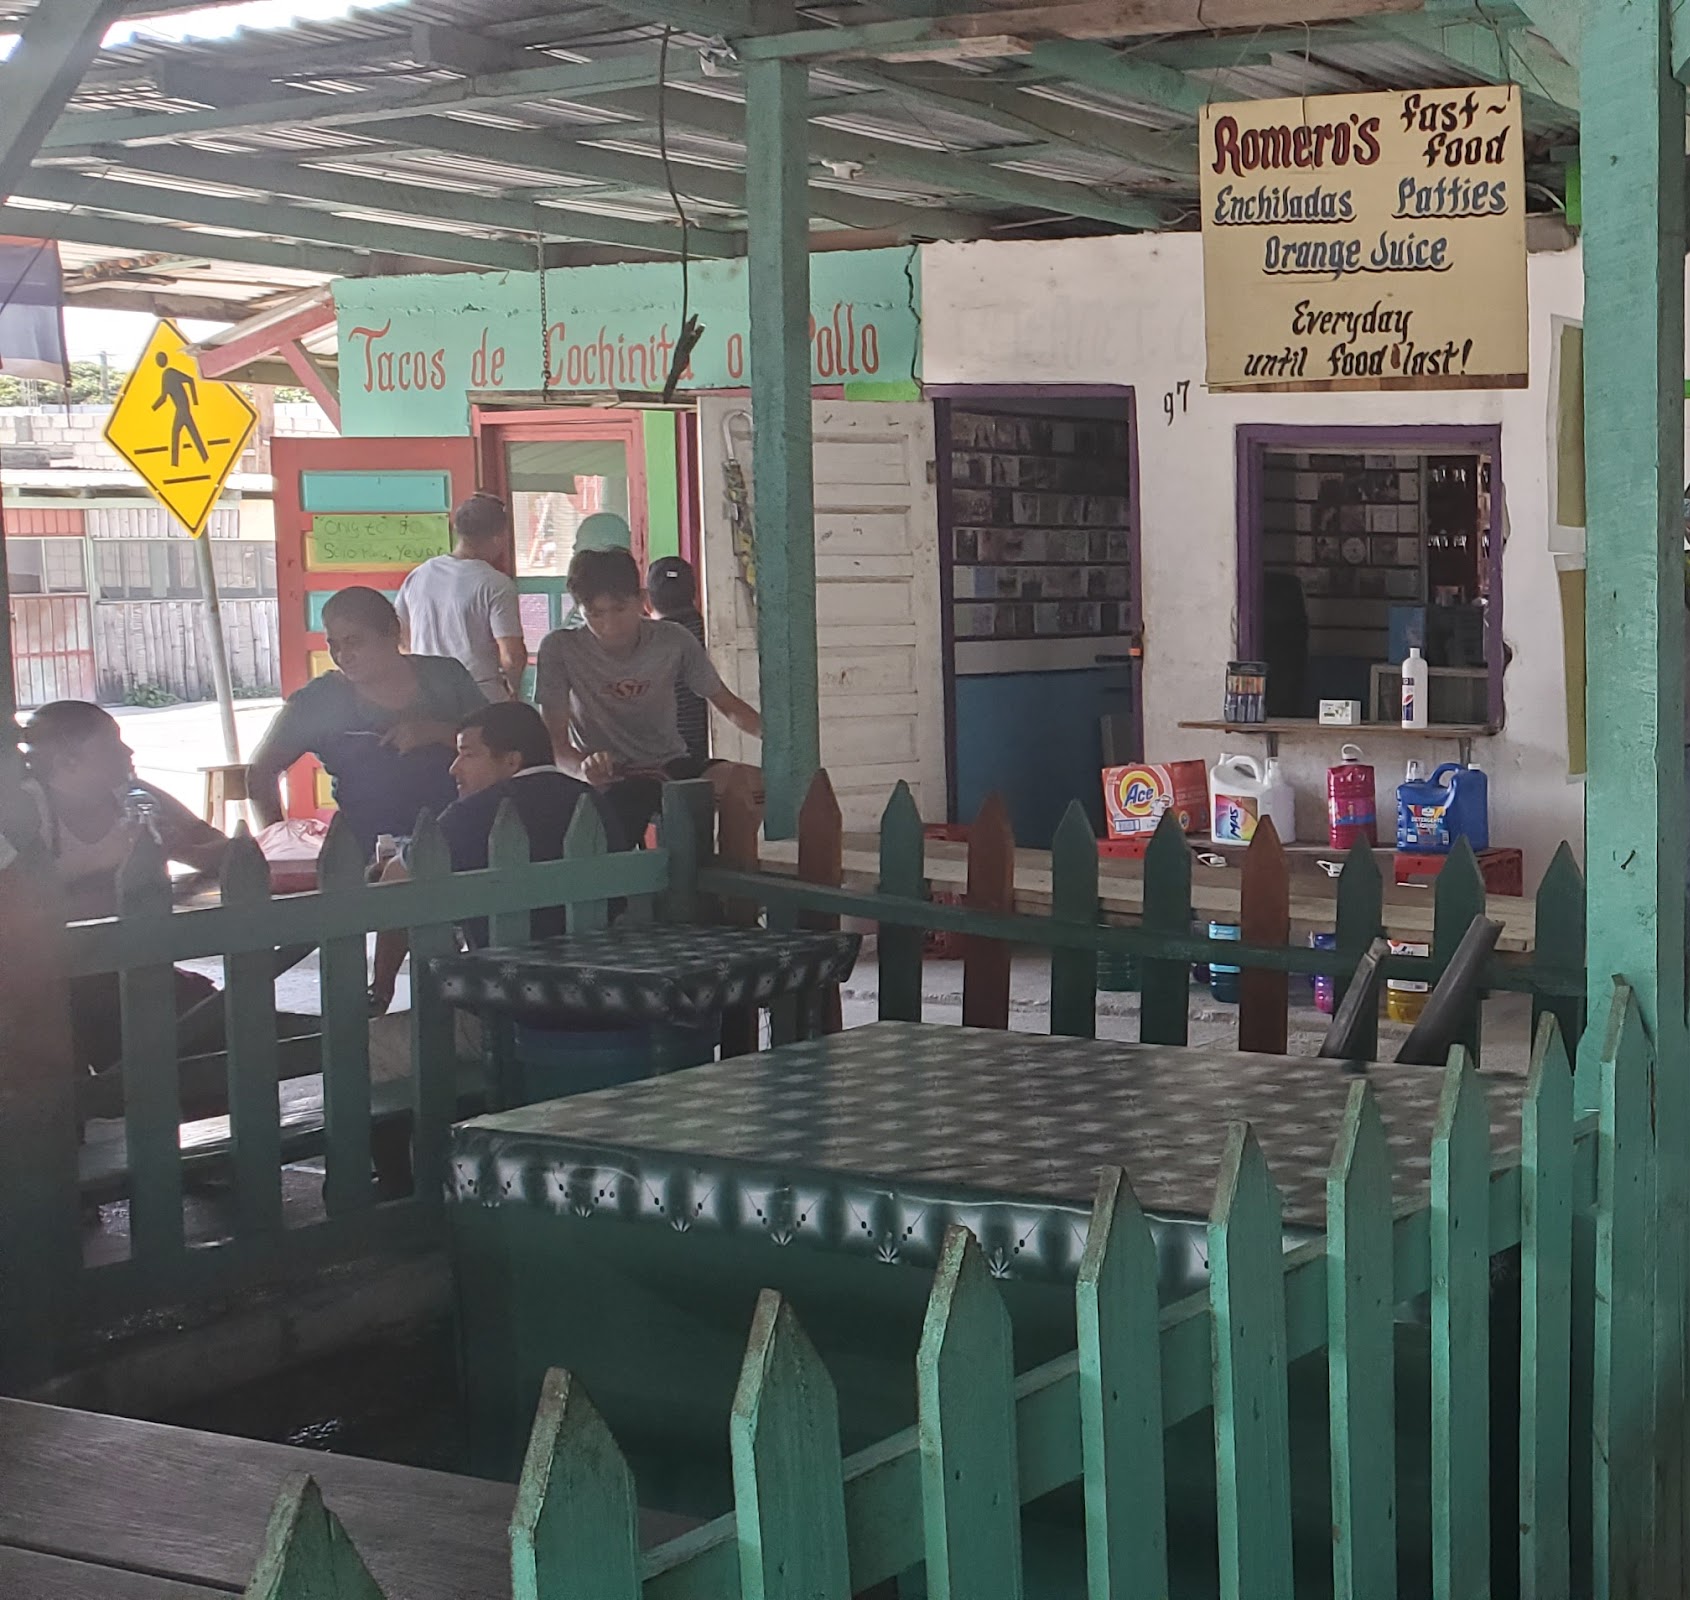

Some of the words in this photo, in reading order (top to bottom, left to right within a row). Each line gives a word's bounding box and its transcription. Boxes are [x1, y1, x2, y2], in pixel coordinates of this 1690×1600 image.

[1423, 126, 1510, 168] food
[1214, 185, 1353, 221] Enchiladas
[1397, 177, 1507, 214] Patties
[1265, 236, 1361, 280] Orange
[1371, 231, 1448, 267] Juice
[1293, 300, 1413, 344] Everyday
[348, 318, 446, 393] Tacos
[471, 327, 505, 388] de
[728, 333, 743, 379] o
[809, 303, 879, 378] ollo
[1245, 347, 1308, 377] until
[1328, 343, 1388, 376] food
[1164, 379, 1191, 426] 97
[1124, 783, 1154, 807] Ace
